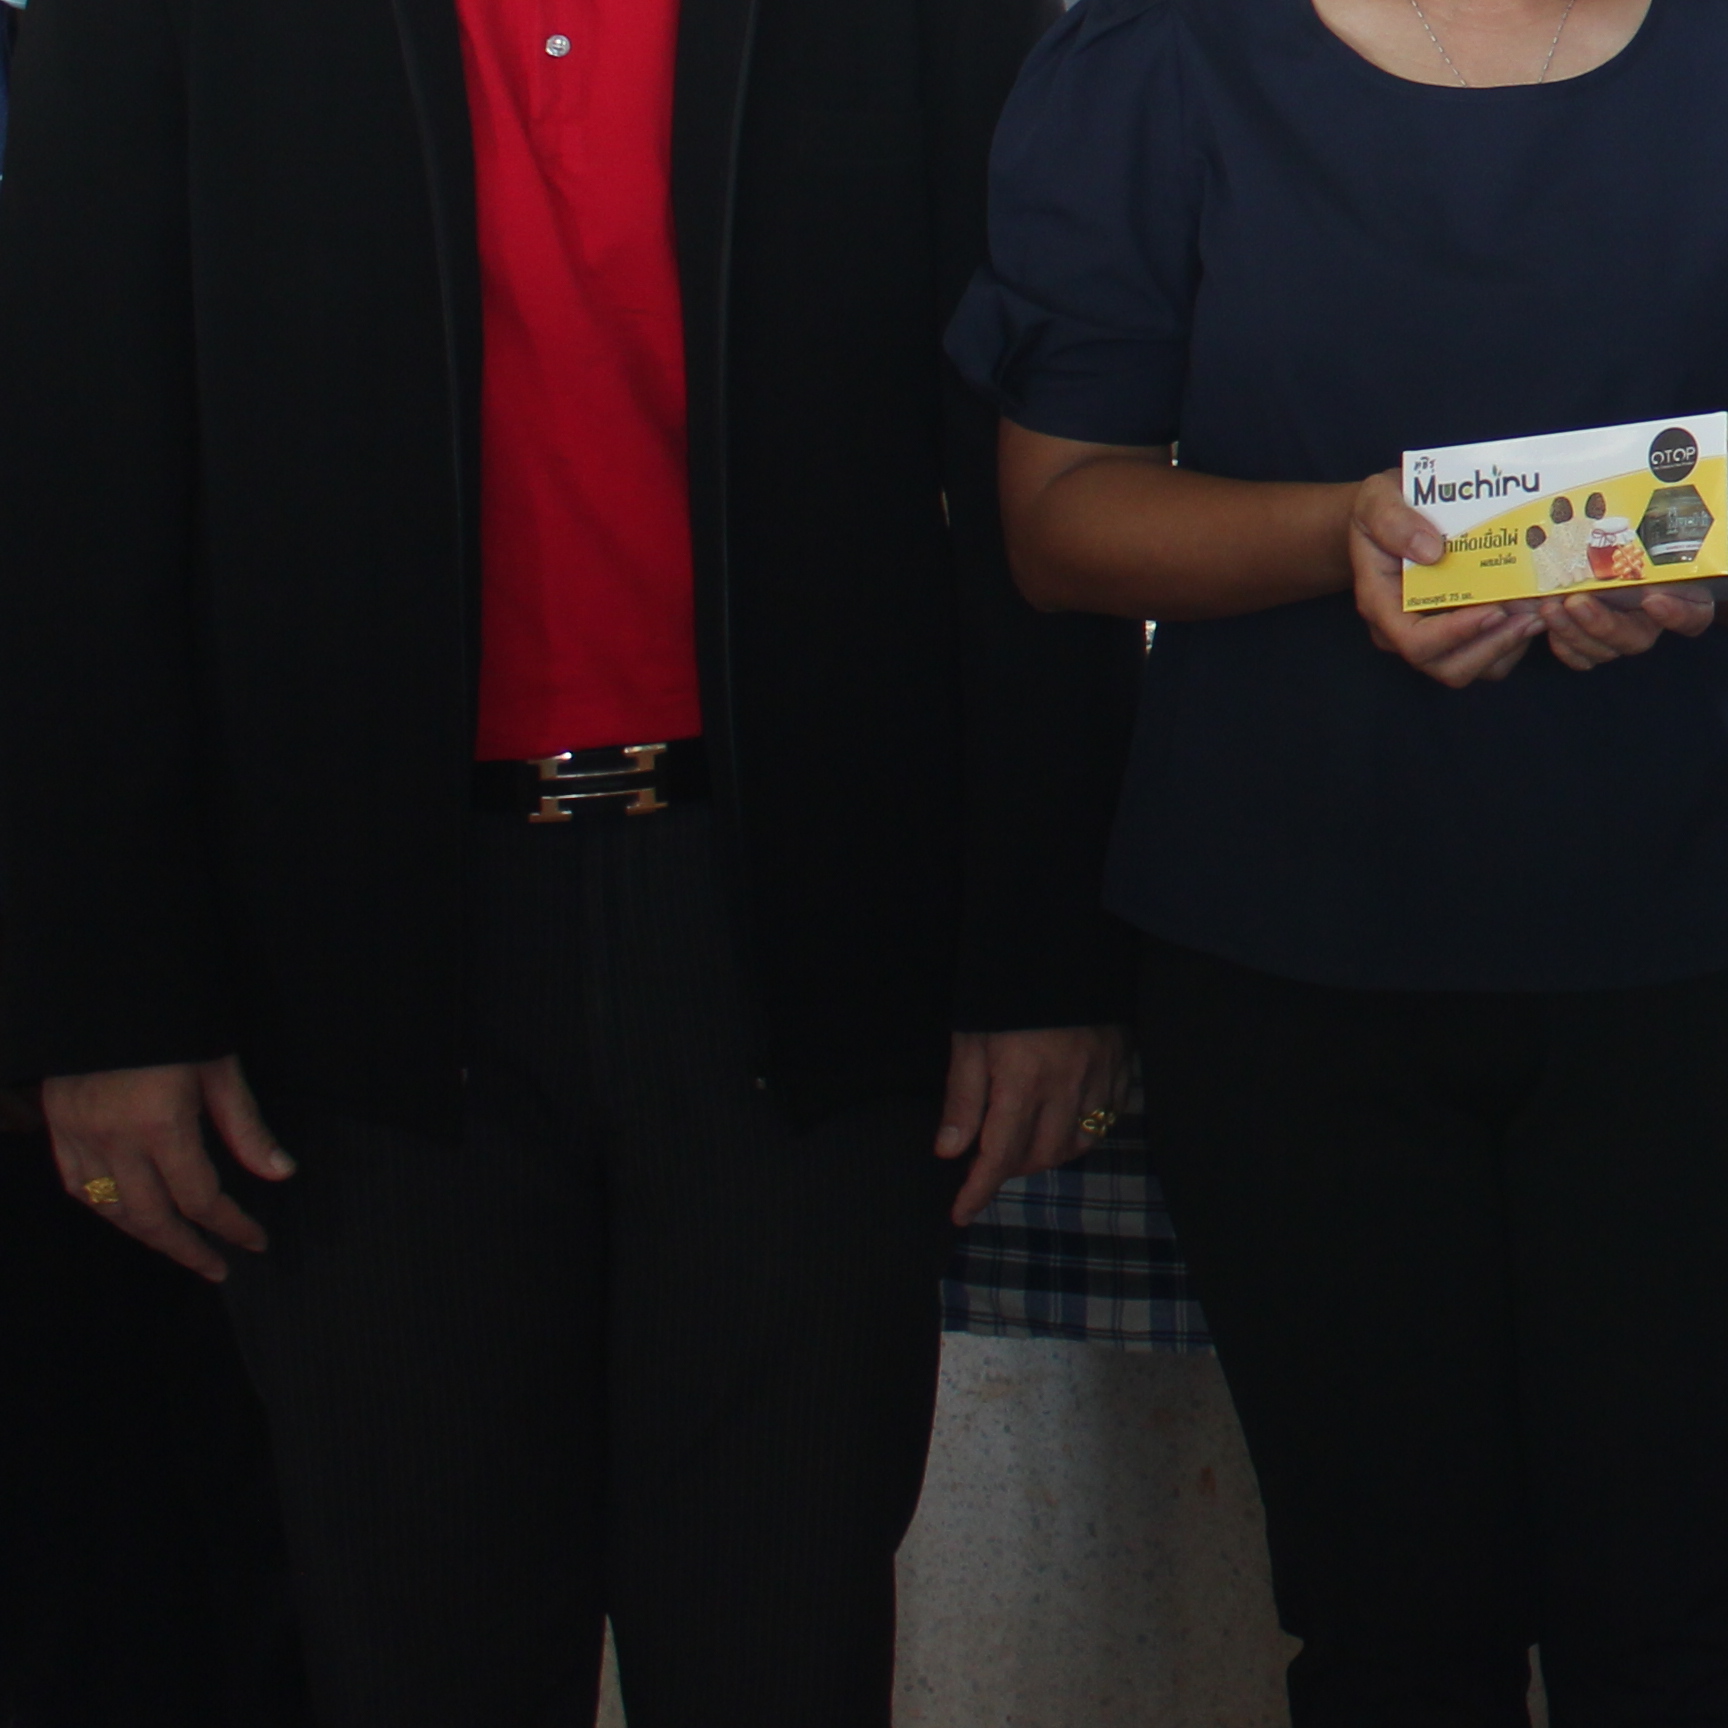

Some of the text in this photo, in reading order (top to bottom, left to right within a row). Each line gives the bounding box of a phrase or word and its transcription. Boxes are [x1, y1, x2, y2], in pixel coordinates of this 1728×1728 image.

[1651, 445, 1696, 465] OTOP
[1413, 466, 1541, 506] Muchiru
[1441, 528, 1519, 554] ้ำเห็ดเยื่อไผ่
[1449, 593, 1460, 601] 75
